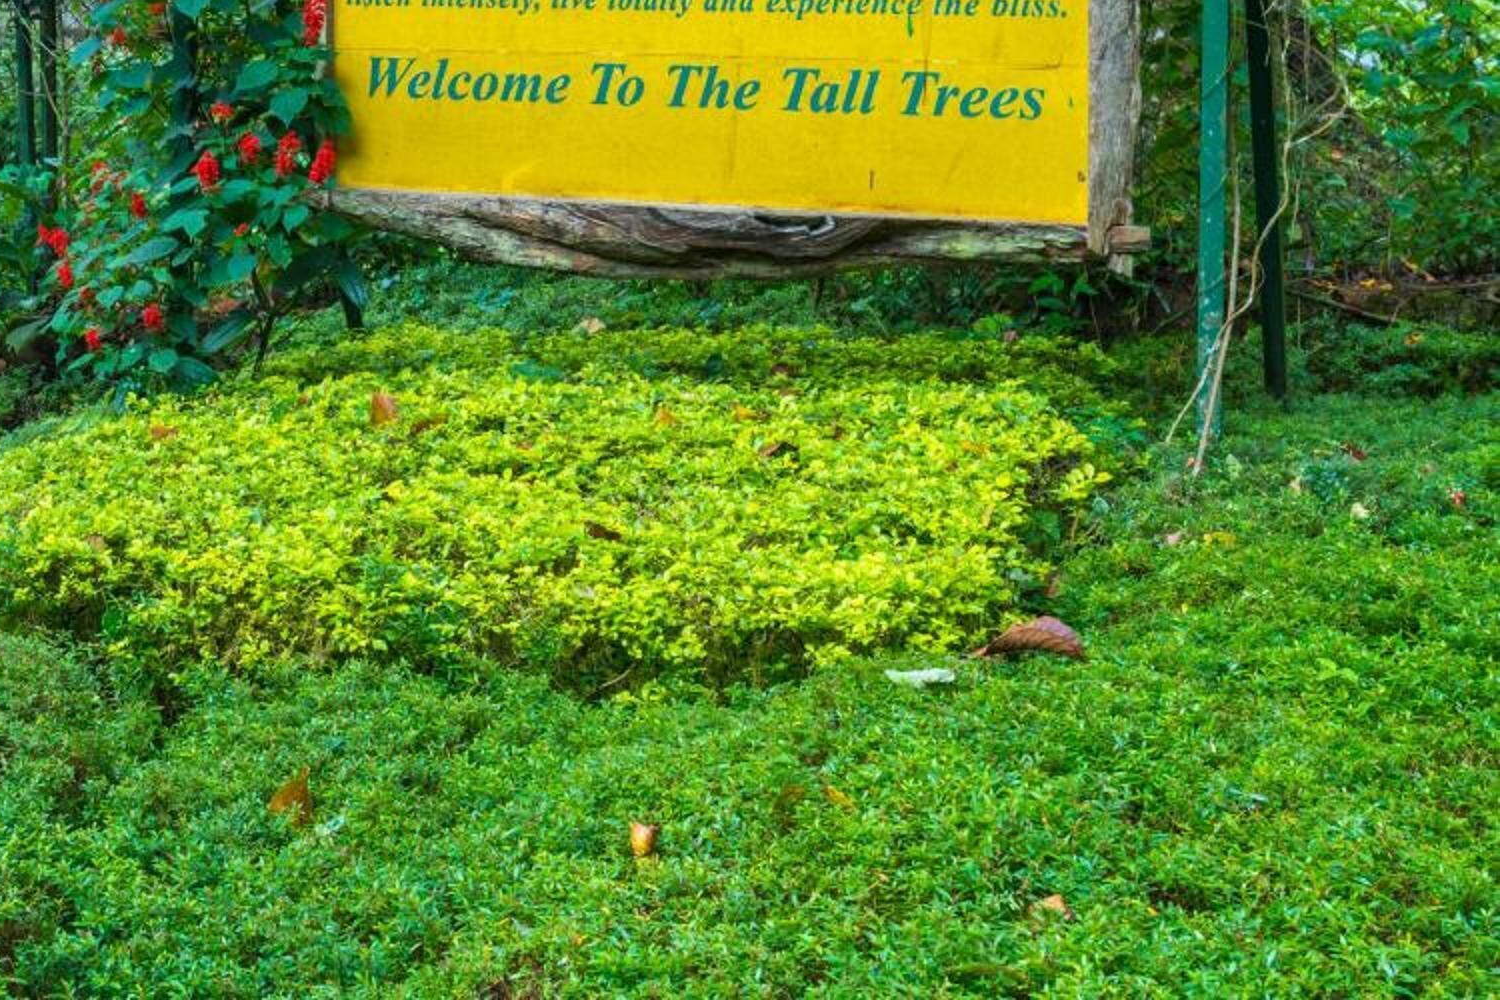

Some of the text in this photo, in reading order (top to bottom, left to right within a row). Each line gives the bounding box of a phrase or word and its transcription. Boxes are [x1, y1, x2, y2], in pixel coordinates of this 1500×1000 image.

[367, 56, 1048, 121] Welcome To The Tall Trees
